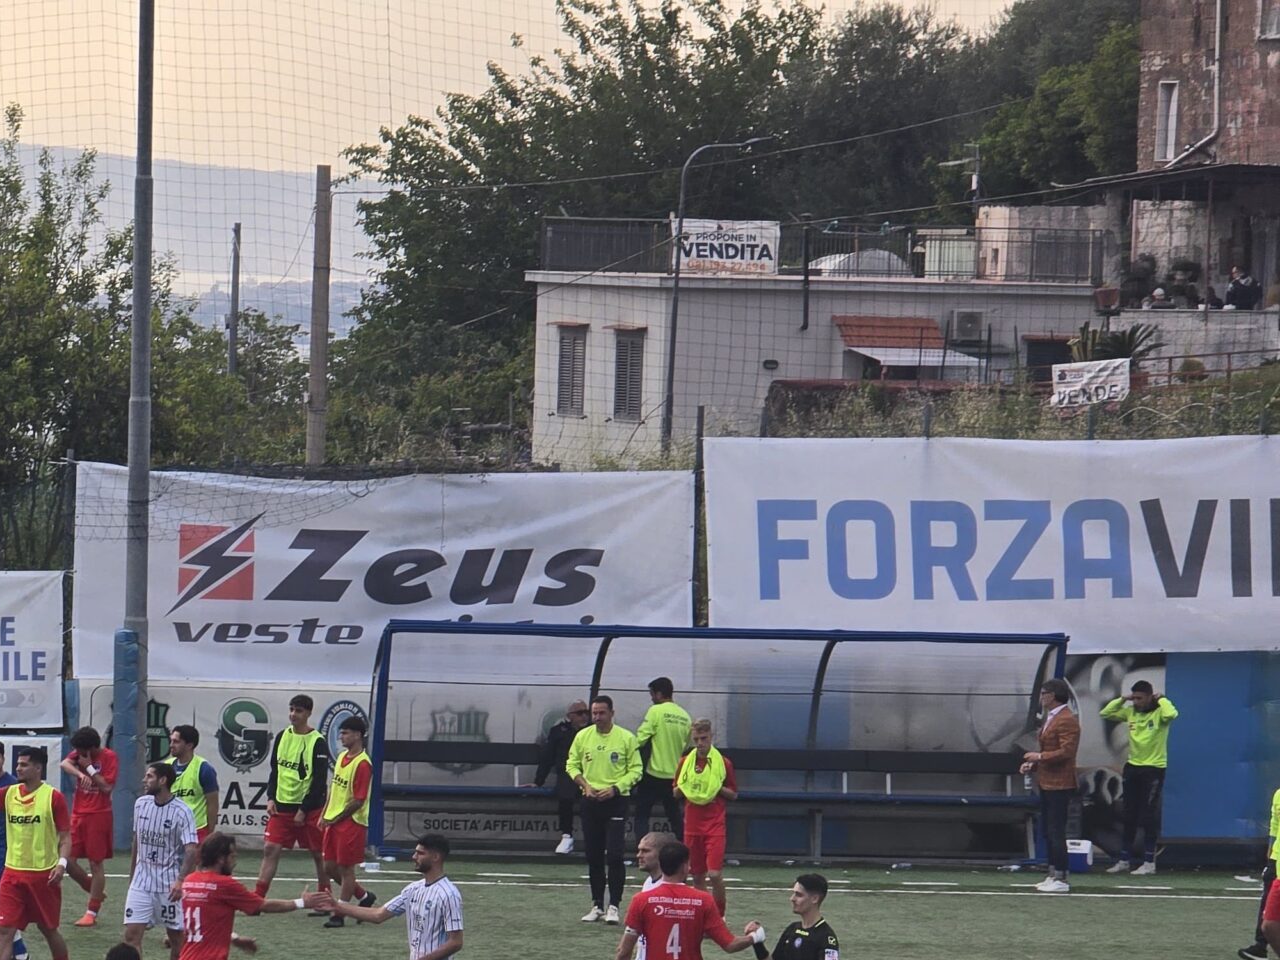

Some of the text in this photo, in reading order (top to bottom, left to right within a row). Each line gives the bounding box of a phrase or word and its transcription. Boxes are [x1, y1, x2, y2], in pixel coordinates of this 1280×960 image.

[696, 232, 756, 243] PROPONE IN
[680, 242, 774, 261] VENDITA
[1057, 384, 1119, 406] VENDE
[264, 529, 605, 606] Zeus
[172, 617, 365, 645] veste
[483, 819, 550, 832] AFFILIATA
[184, 906, 204, 943] 11
[666, 923, 682, 960] 4
